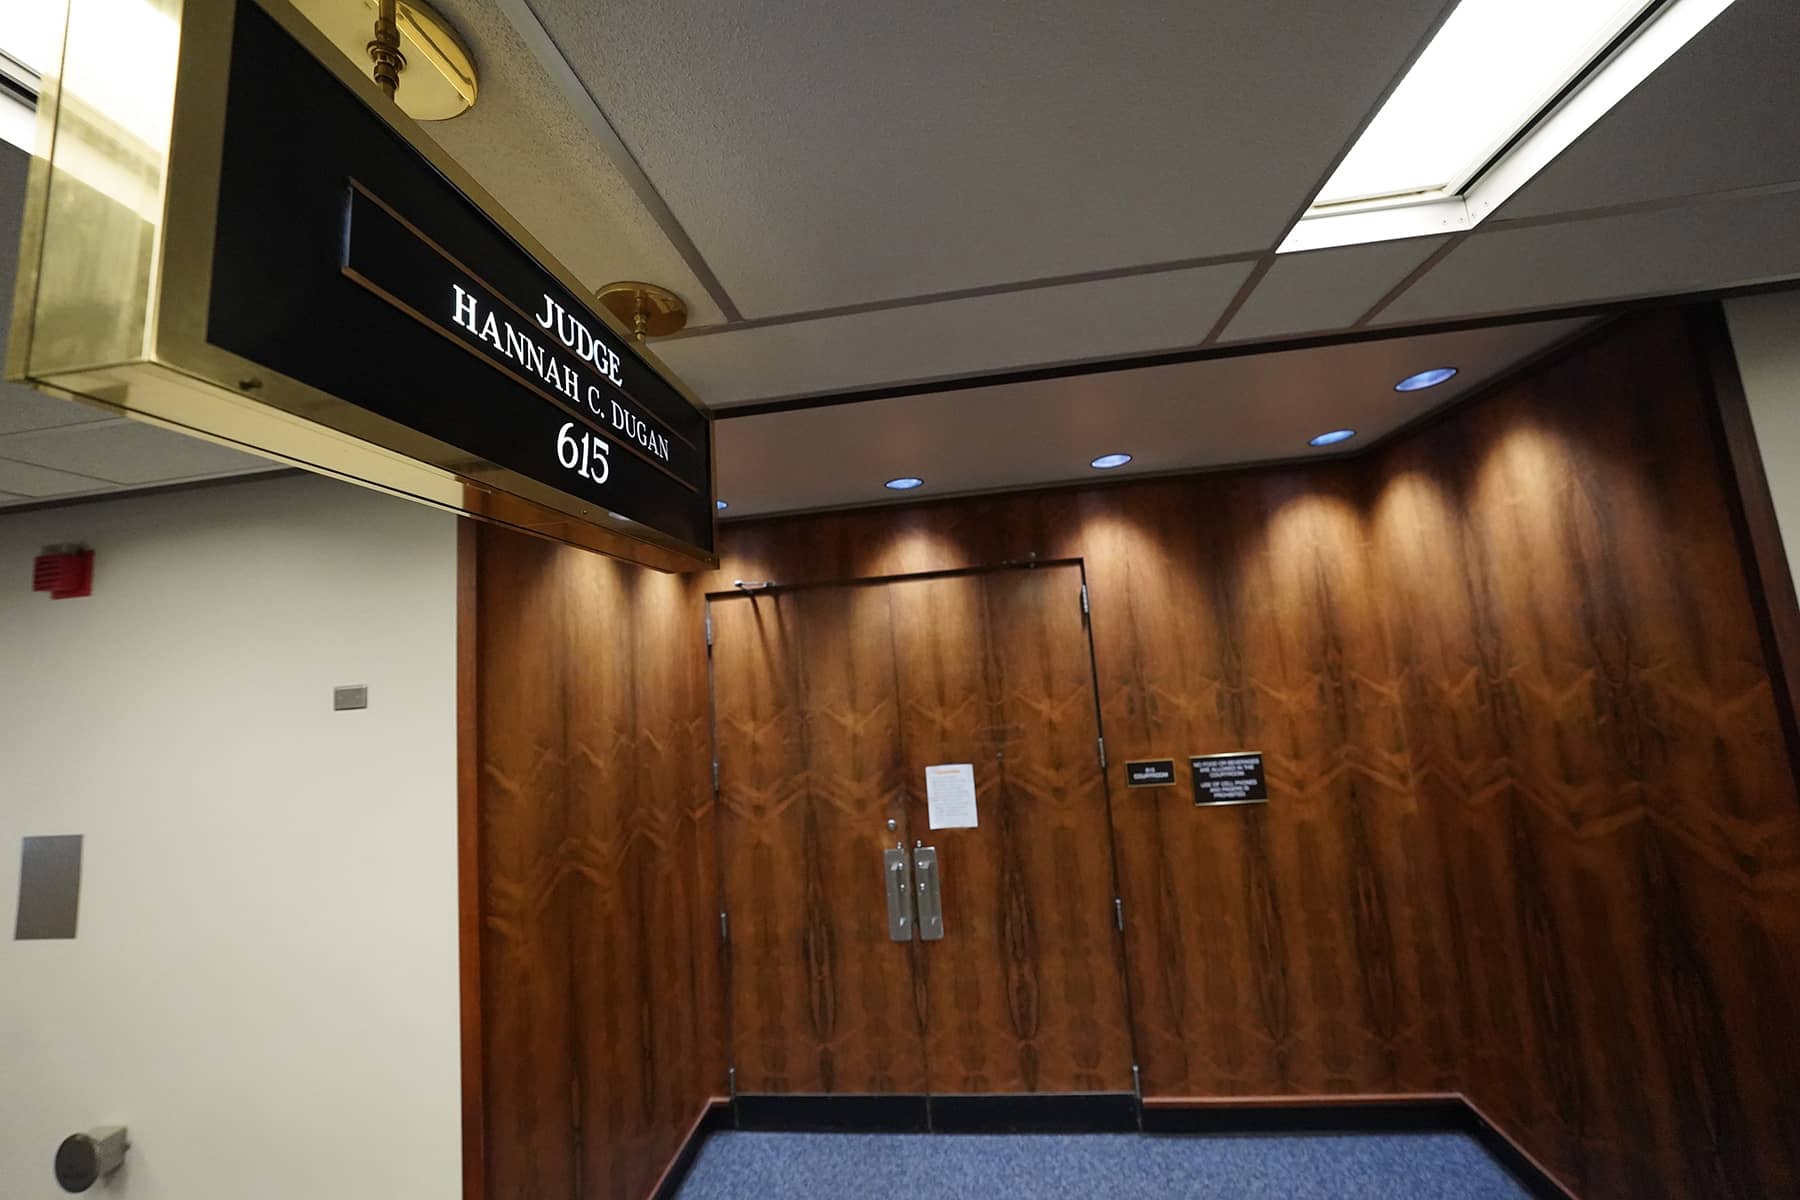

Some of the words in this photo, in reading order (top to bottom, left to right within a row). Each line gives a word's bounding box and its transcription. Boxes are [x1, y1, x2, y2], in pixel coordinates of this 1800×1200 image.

[452, 284, 581, 402] HANNAH
[587, 386, 605, 418] C.
[610, 400, 669, 462] DUGAN
[536, 294, 623, 387] JUDGE
[557, 422, 609, 484] 615
